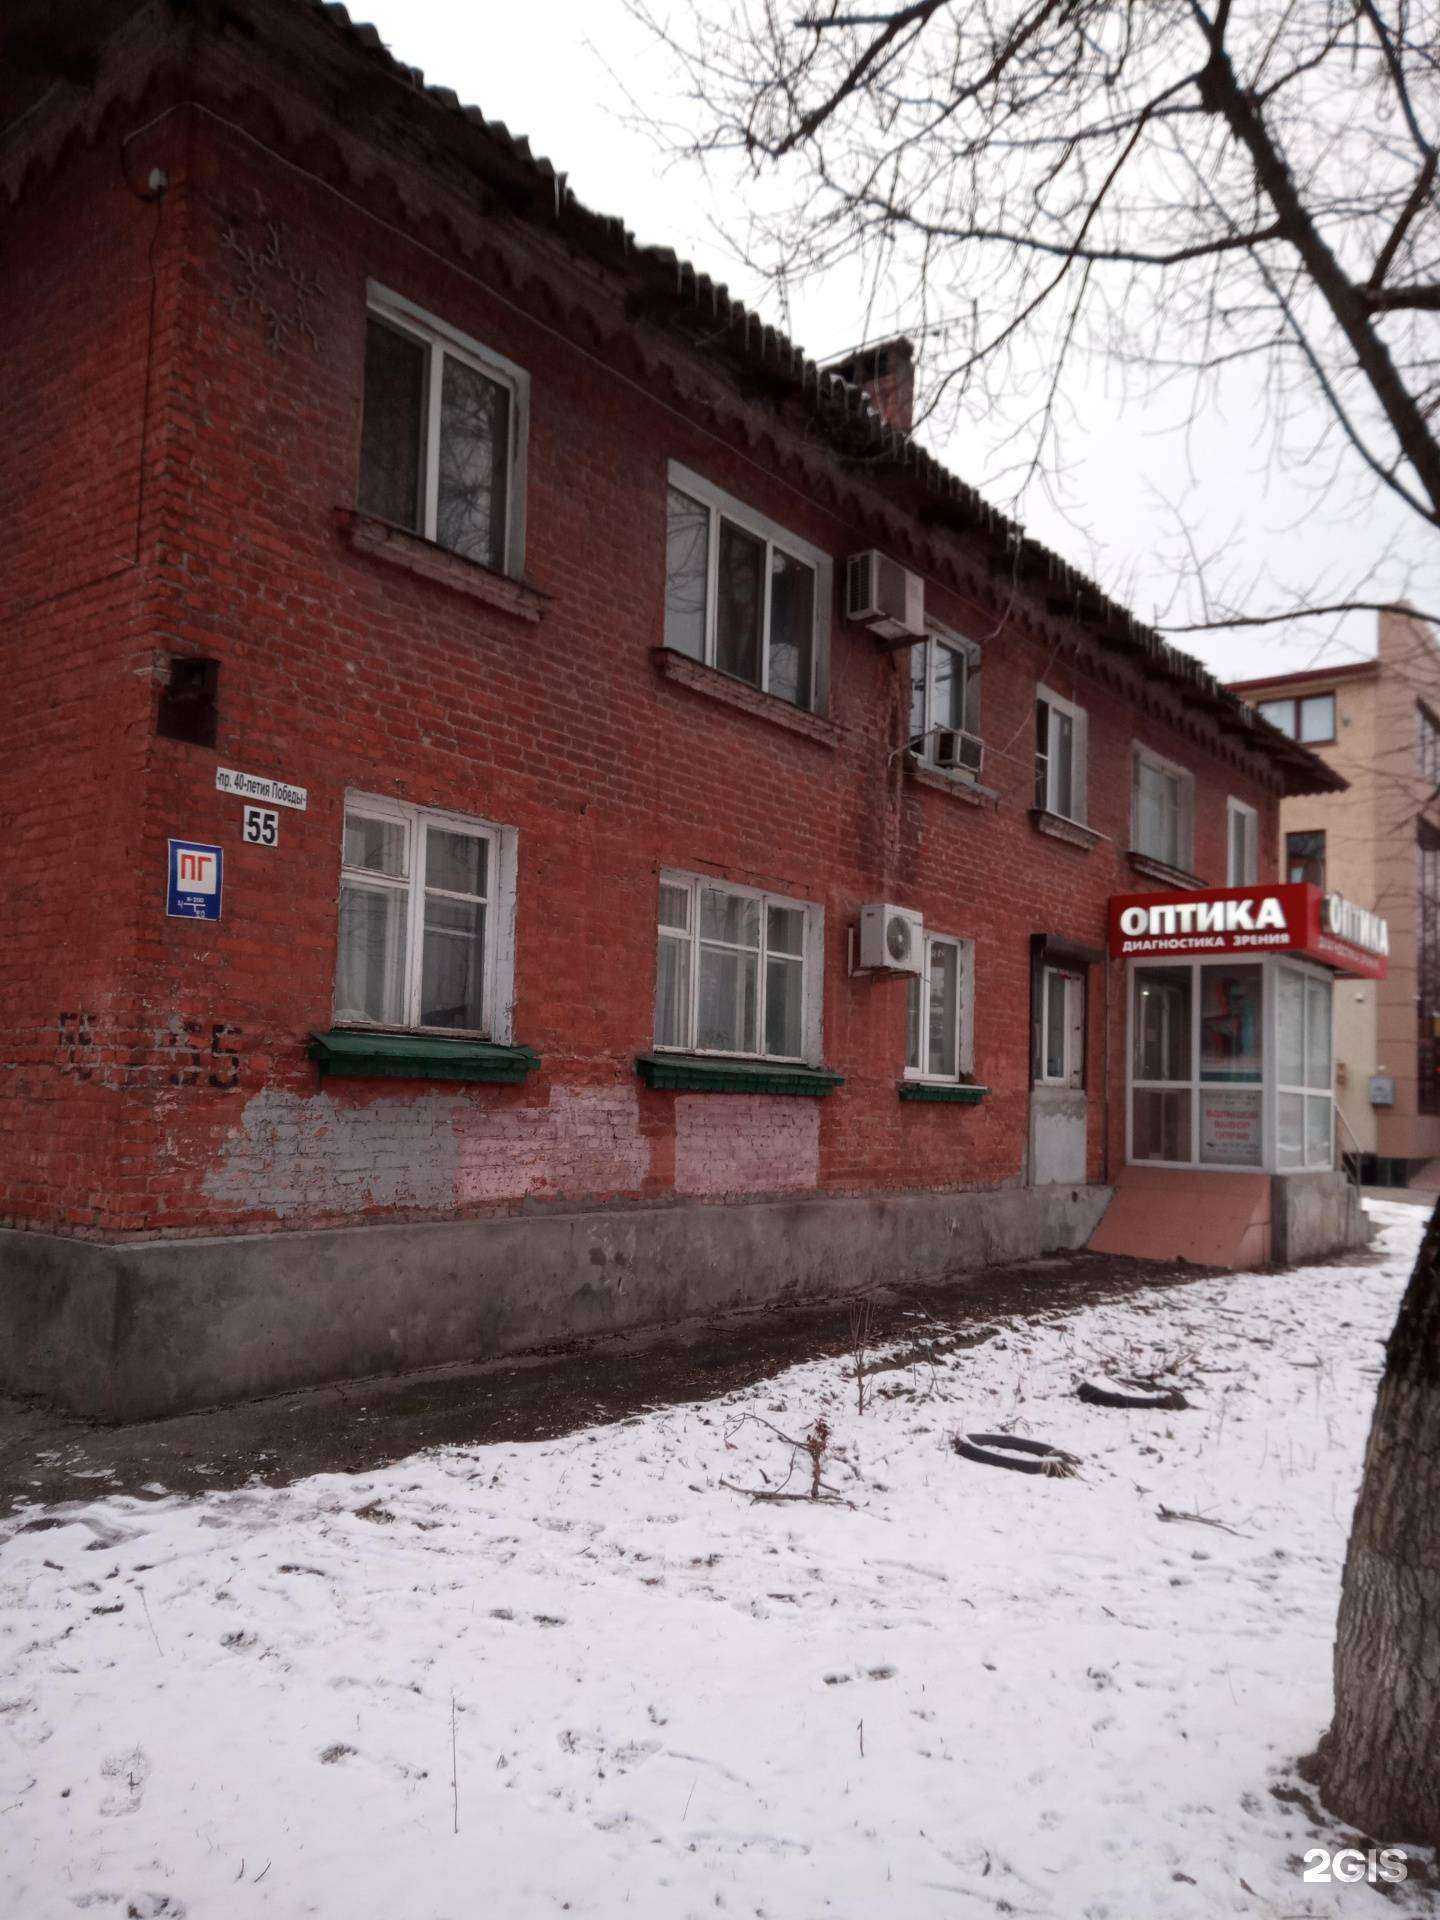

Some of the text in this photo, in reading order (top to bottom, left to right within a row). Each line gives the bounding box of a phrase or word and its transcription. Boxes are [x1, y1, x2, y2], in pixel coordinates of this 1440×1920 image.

[219, 773, 303, 805] пр. 40-летия Победы
[247, 810, 276, 844] 55
[181, 853, 212, 881] ПГ
[1120, 897, 1287, 936] ОПТИКА
[1329, 893, 1389, 957] ОПТИКА
[1122, 933, 1291, 953] ДИАГНОСТИКА ЗРЕНИЯ
